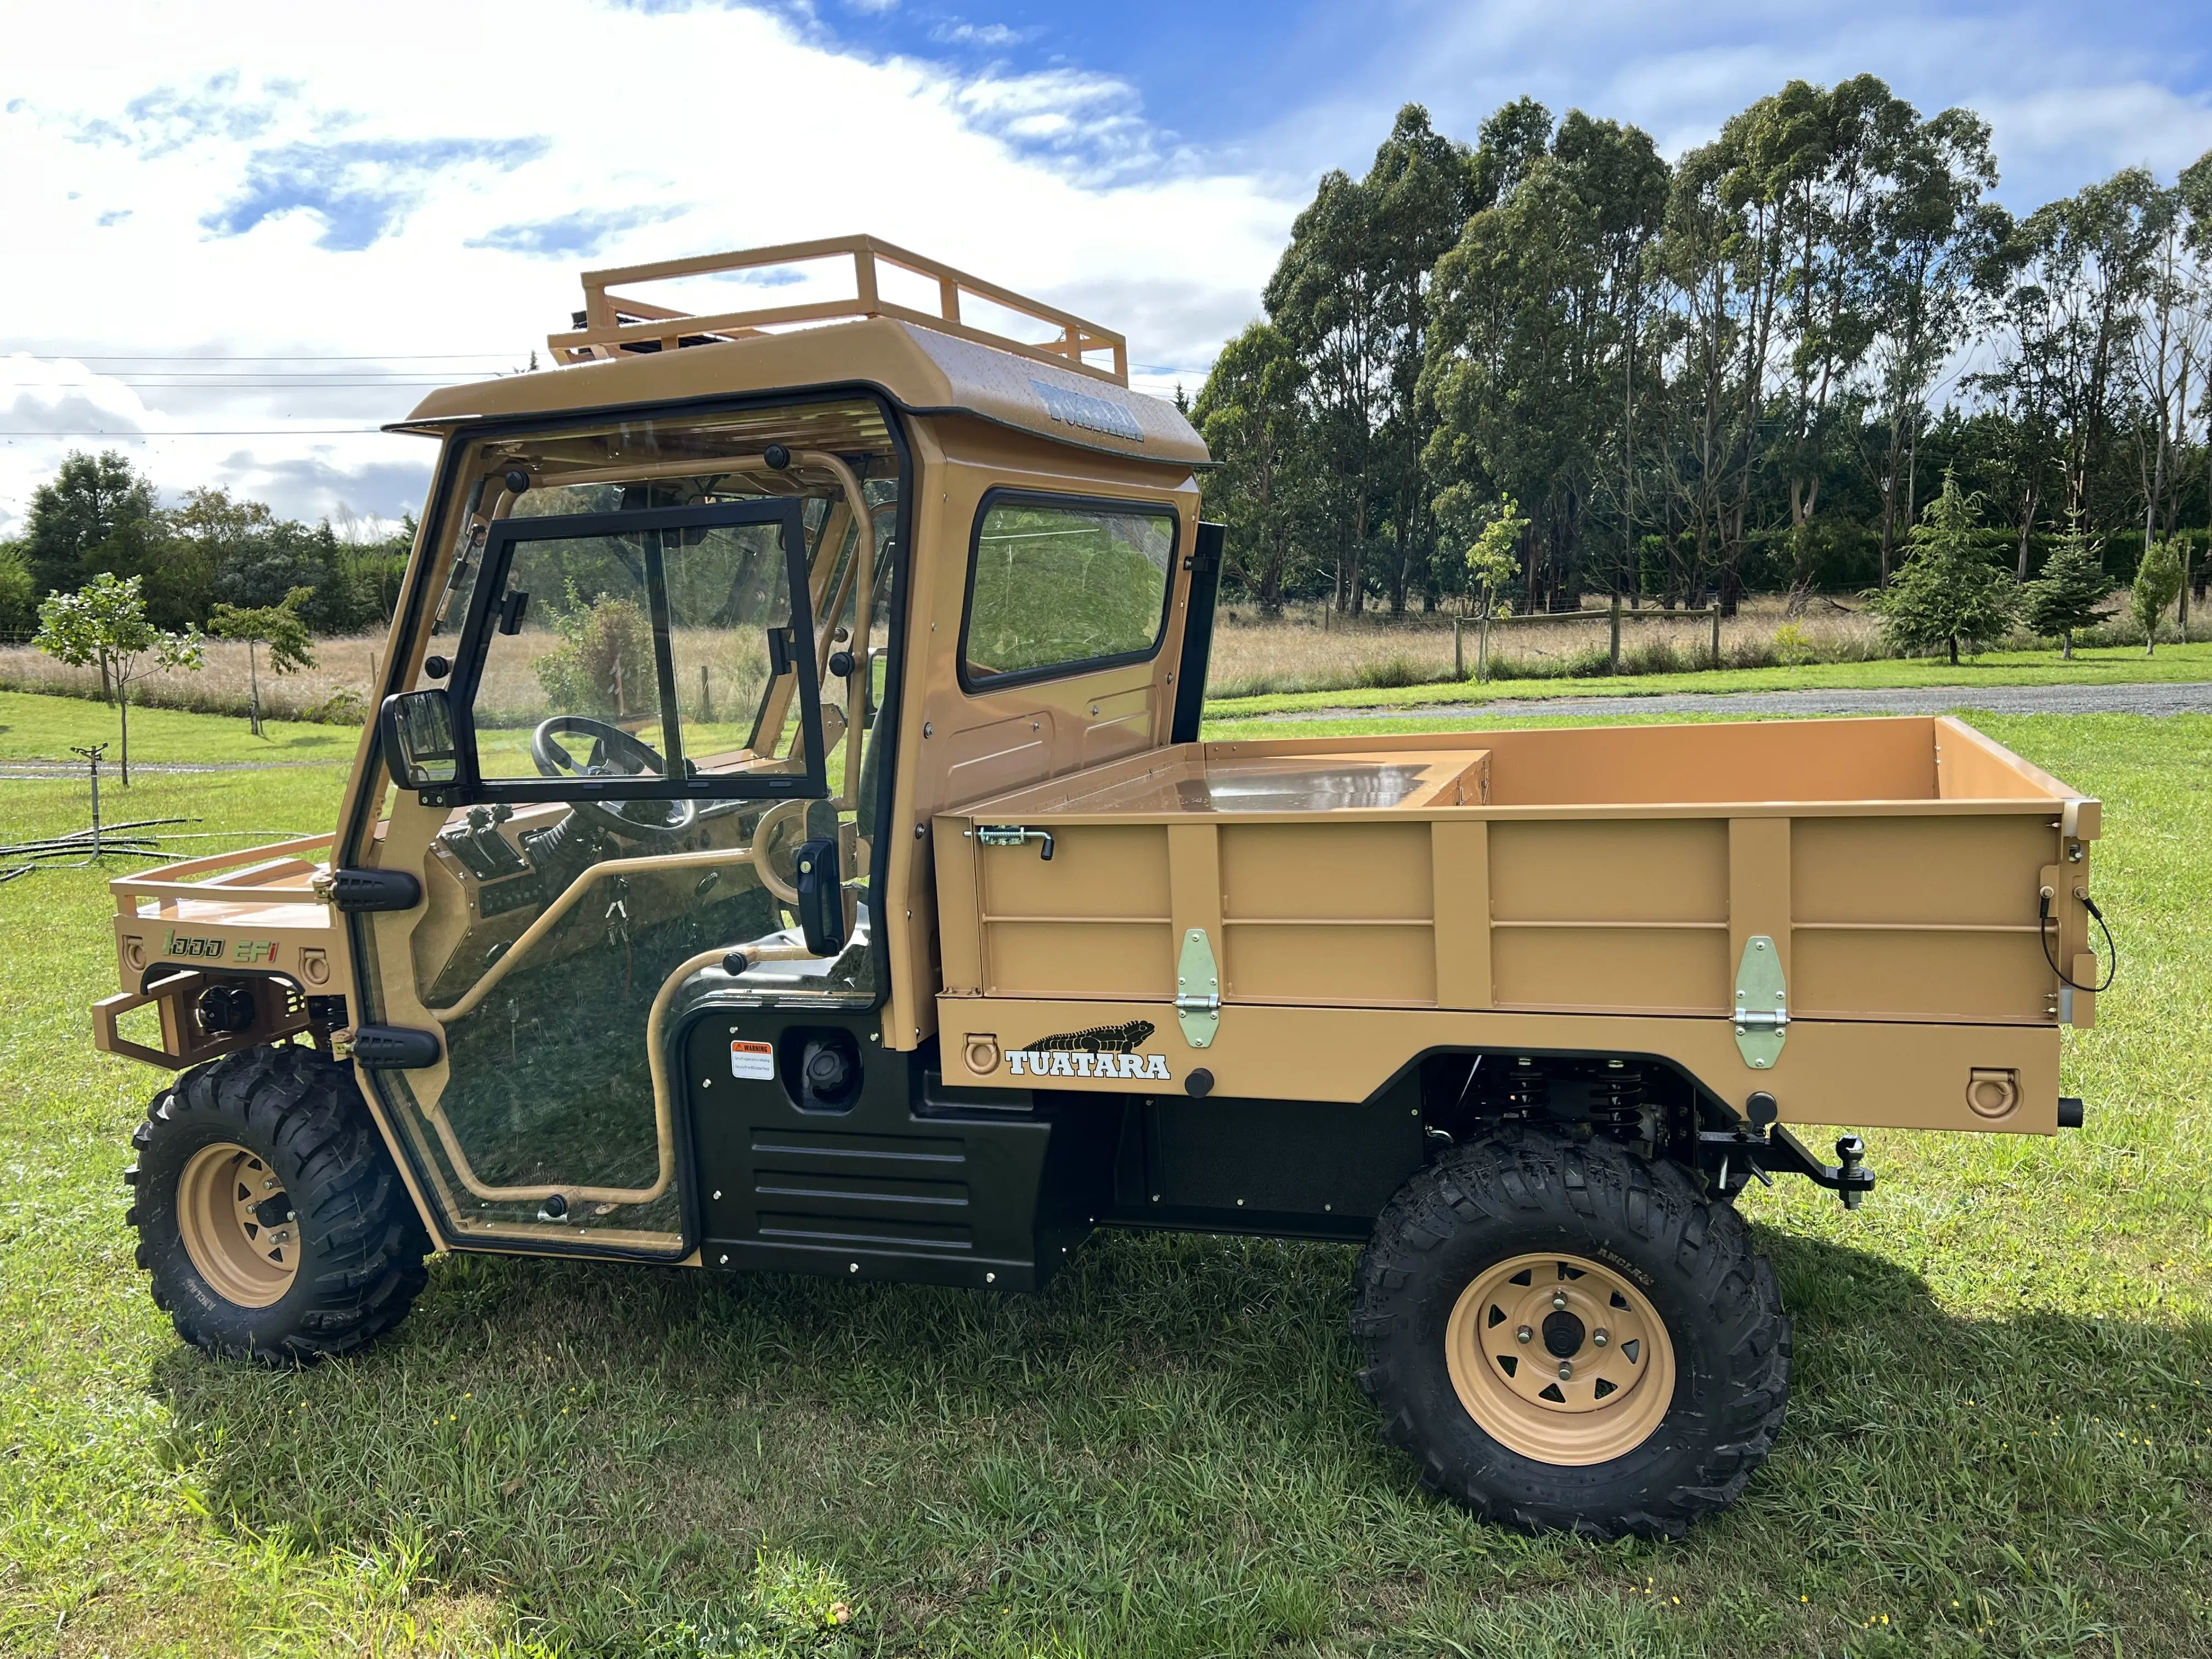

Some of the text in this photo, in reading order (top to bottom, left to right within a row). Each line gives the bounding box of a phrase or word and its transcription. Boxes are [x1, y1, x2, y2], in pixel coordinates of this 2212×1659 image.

[162, 928, 279, 963] 1000 EFi
[744, 1045, 768, 1053] WARNING
[1005, 1050, 1171, 1080] TUATARA
